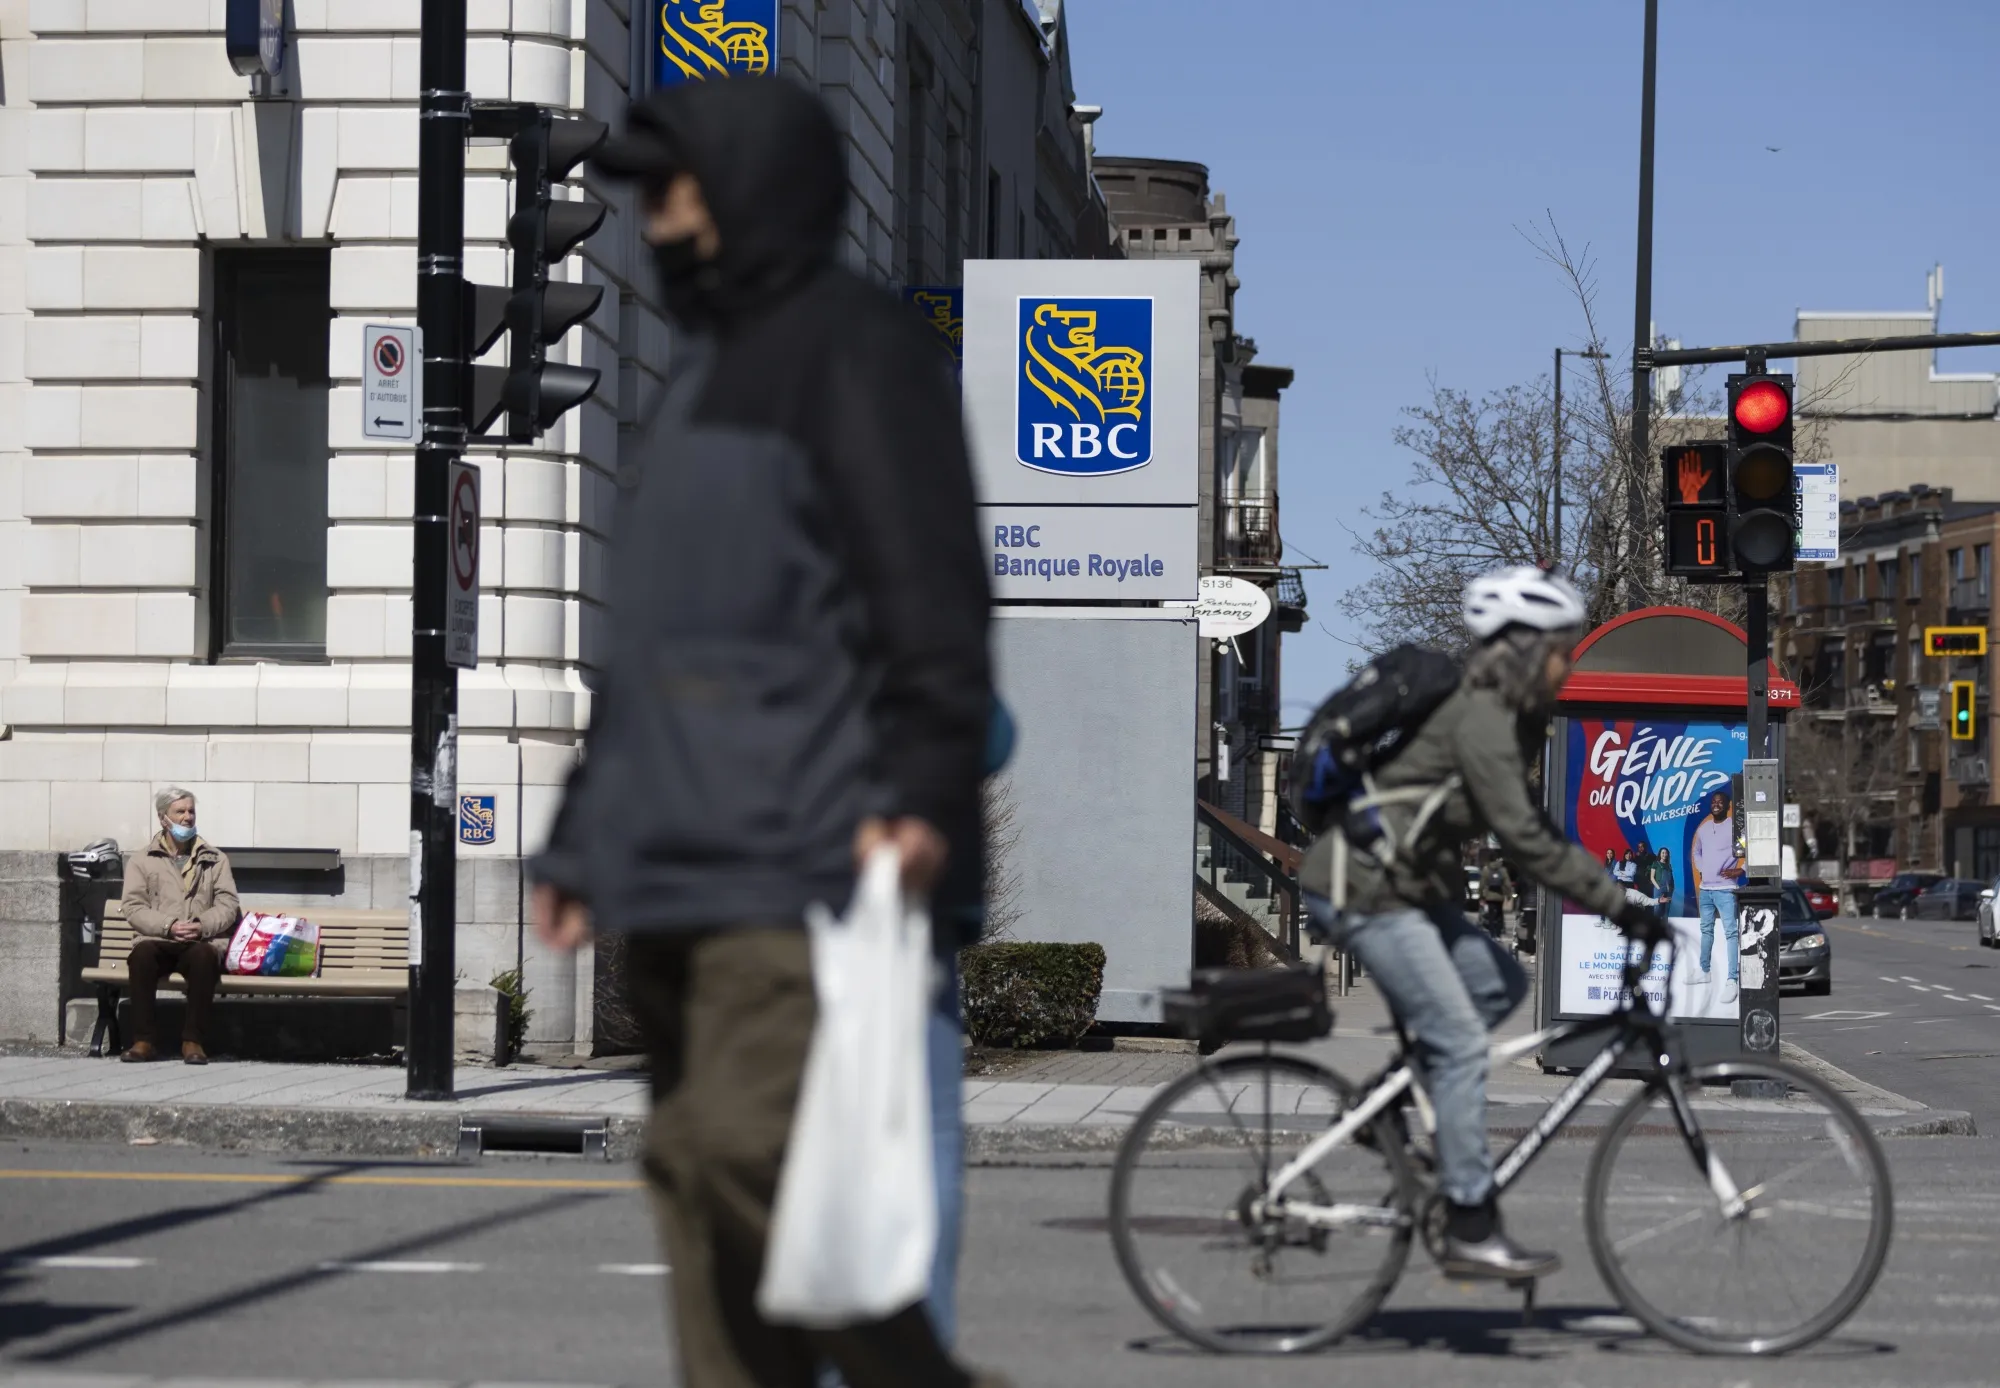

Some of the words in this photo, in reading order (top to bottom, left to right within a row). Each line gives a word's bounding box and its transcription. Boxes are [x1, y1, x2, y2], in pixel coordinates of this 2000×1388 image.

[1031, 422, 1139, 459] RBC
[994, 525, 1041, 548] RBC
[1697, 519, 1715, 565] 0
[994, 553, 1080, 582] Banque
[1088, 553, 1164, 583] Royale
[1202, 580, 1233, 589] 5136
[1204, 598, 1258, 608] Restaurant
[1731, 729, 1748, 740] ing.
[1589, 727, 1722, 782] GÉNIE
[1615, 769, 1730, 825] QUOI?
[1641, 814, 1651, 825] LA
[463, 828, 492, 839] RBC
[1594, 952, 1607, 960] UN
[1636, 954, 1662, 962] DNS
[1648, 964, 1675, 972] PORT
